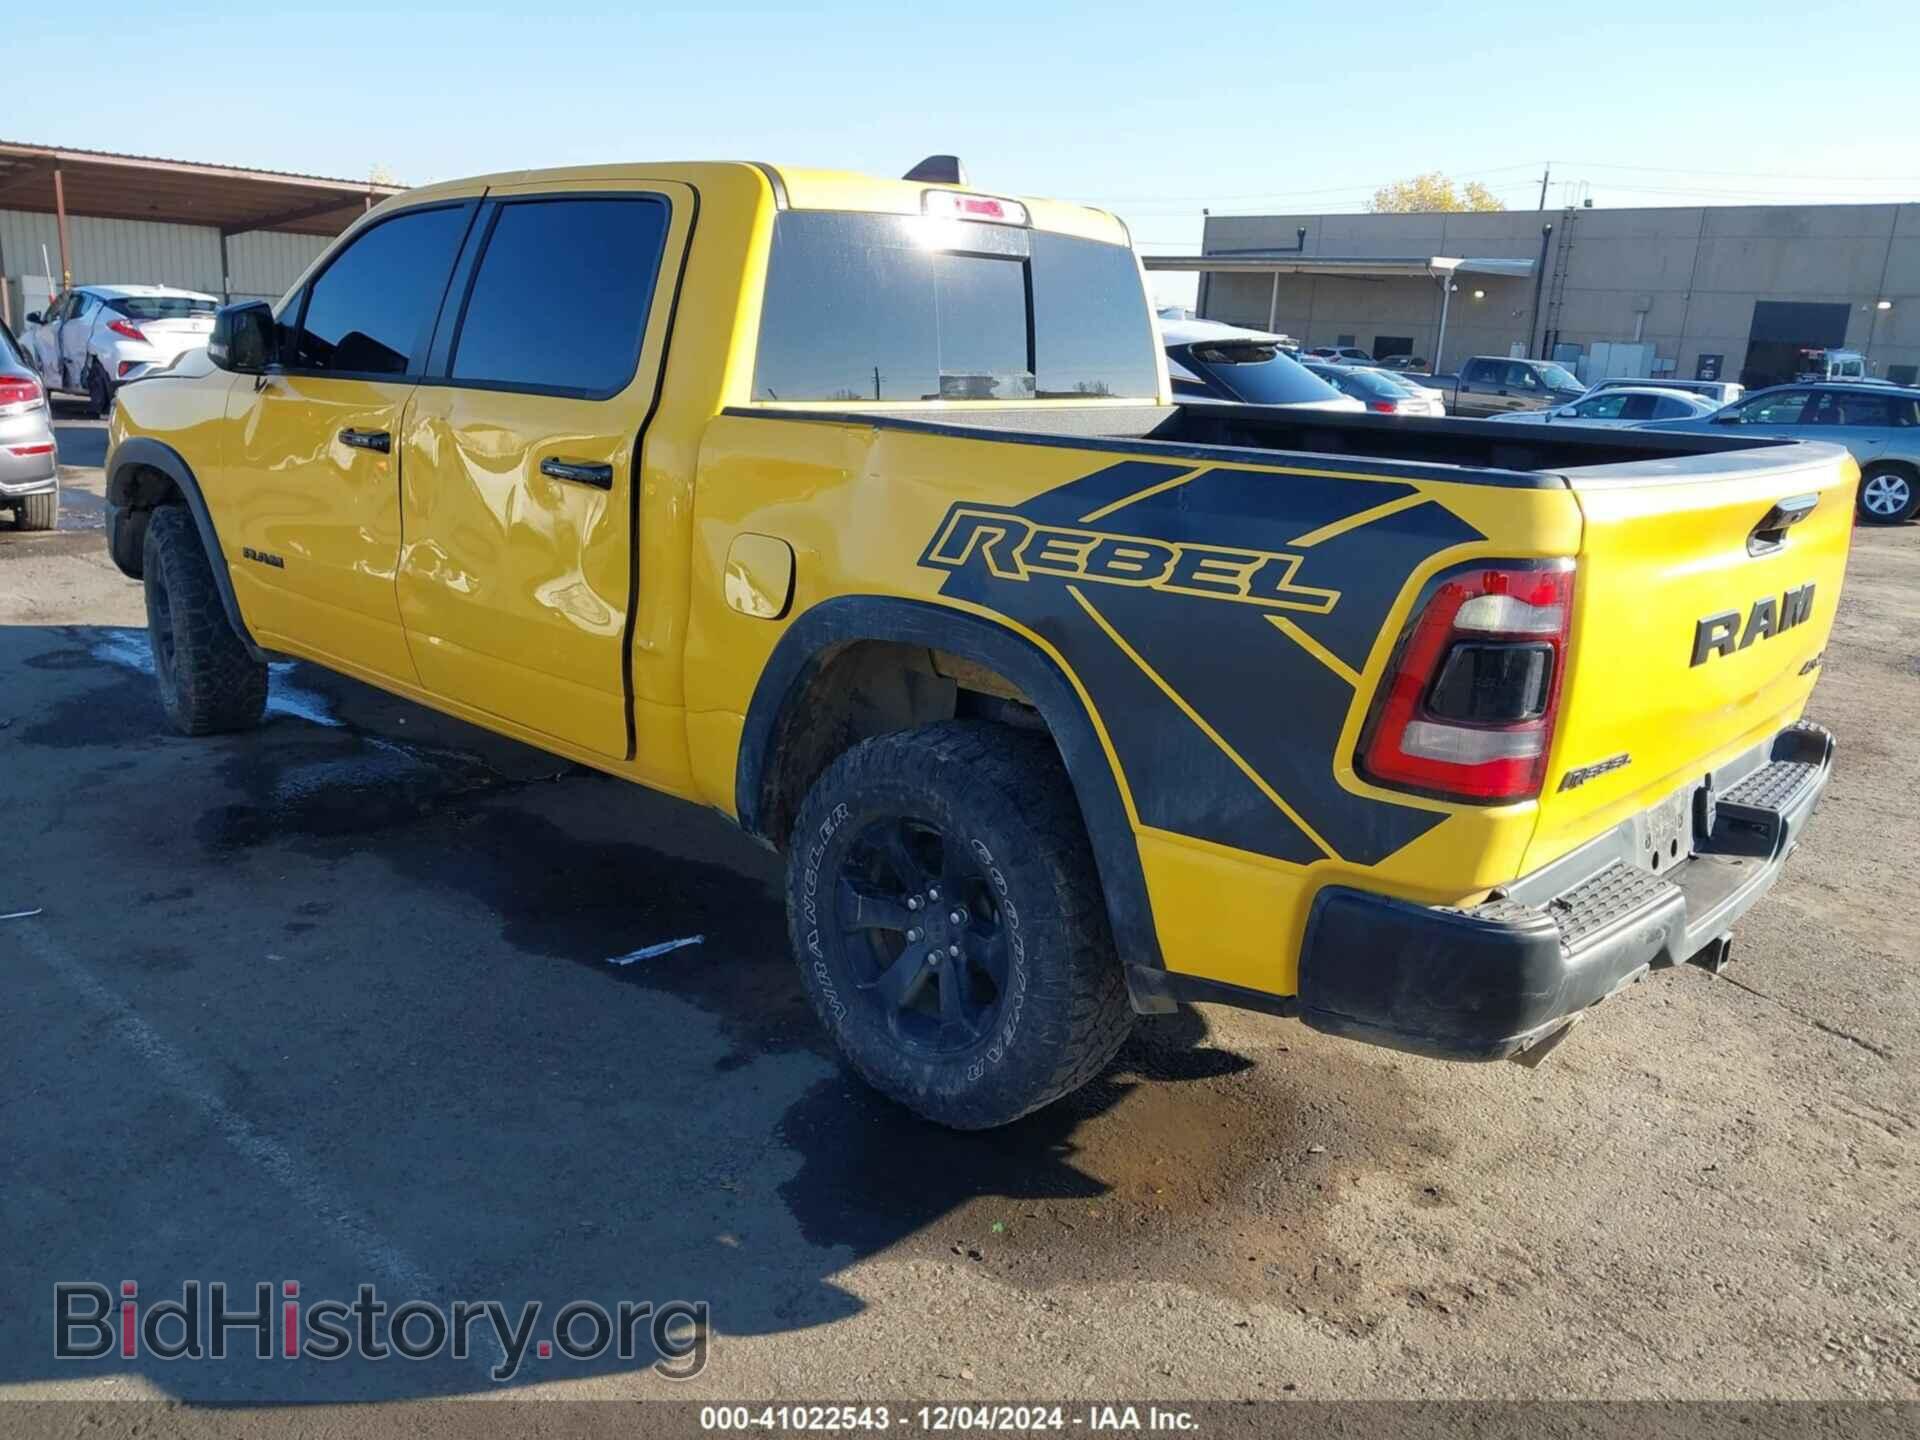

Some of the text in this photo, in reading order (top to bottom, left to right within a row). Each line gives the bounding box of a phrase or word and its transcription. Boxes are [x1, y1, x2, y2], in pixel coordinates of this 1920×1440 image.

[242, 547, 285, 569] RAM
[926, 508, 1342, 615] REBEL
[1688, 582, 1817, 669] RAM
[801, 802, 849, 1023] WRANGLER
